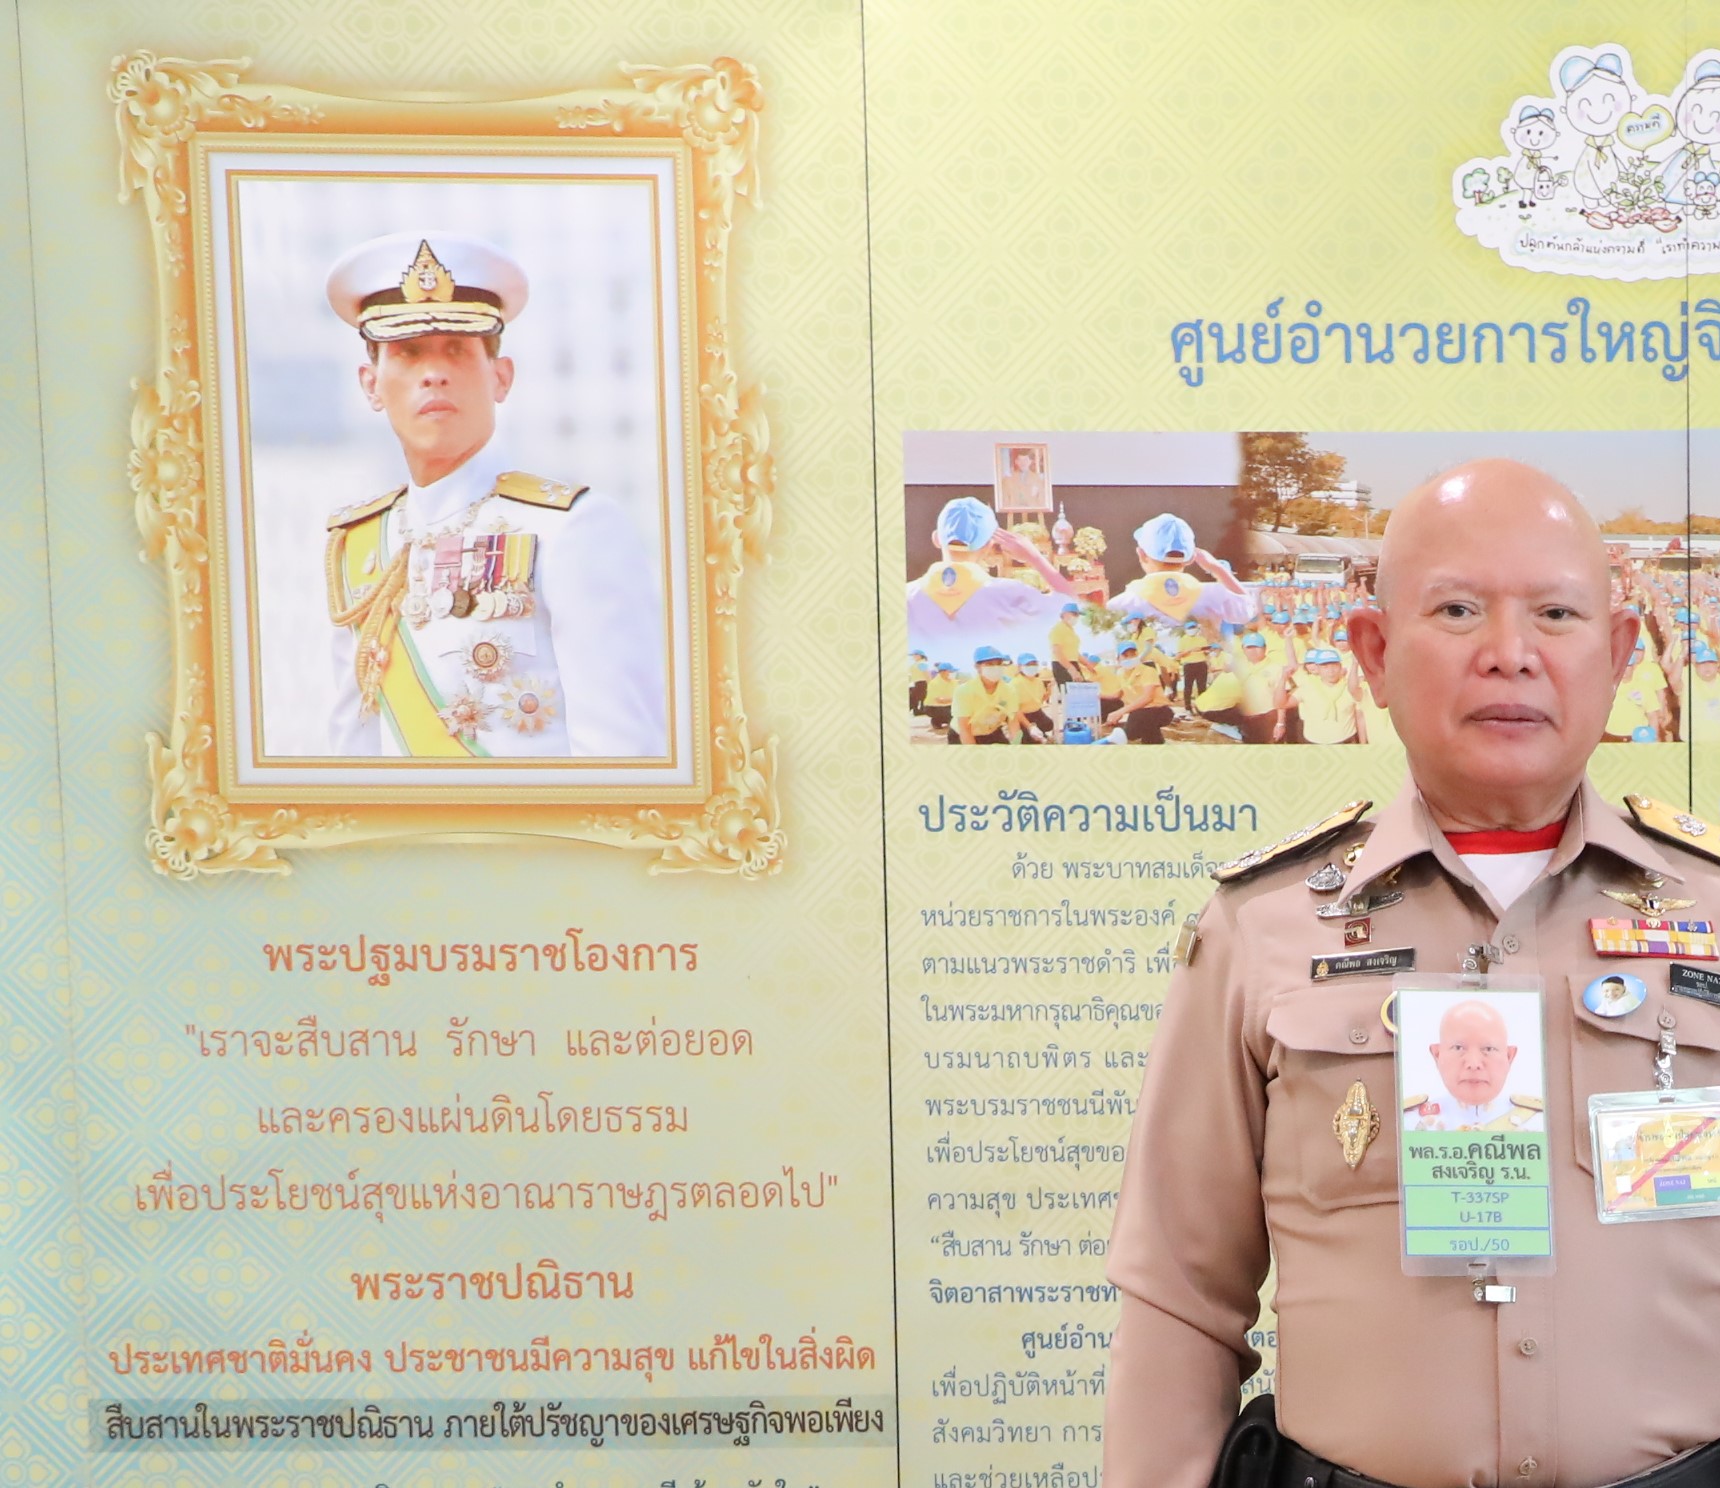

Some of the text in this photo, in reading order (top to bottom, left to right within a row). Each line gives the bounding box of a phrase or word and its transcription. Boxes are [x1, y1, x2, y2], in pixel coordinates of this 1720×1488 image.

[919, 786, 1257, 834] ประวัติความเป็นมา
[1012, 857, 1053, 881] ด้วย
[921, 899, 1176, 928] หน่วยราชการในพระองค์
[263, 928, 699, 985] พระปฐมบรมราชโองการ
[922, 943, 1177, 976] ตามแนวพระราชดำริ เพื่
[1682, 969, 1705, 981] ZONE
[185, 1014, 754, 1059] "เราจะสืบสาน รักษา และต่อยอด
[924, 1042, 1092, 1069] บรมนาถบพิตร
[257, 1092, 689, 1136] และครองแผ่นดินโดยธรรม
[927, 1131, 1125, 1171] เพื่อประโยชน์สุขขอ
[1409, 1135, 1541, 1161] พล.ร.อ.คณีพล
[1432, 1162, 1531, 1185] สงเจริญ ร.น.
[135, 1163, 840, 1222] เพื่อประโยชน์สุขแห่งอาณาราษฎรตลอดไป"
[928, 1190, 1016, 1218] ความสุข
[1451, 1192, 1510, 1205] T-337SP
[1459, 1210, 1503, 1223] U-17B
[930, 1230, 1110, 1258] “สืบสาน รักษา ต่อ
[1449, 1237, 1511, 1252] รอป./50
[351, 1259, 635, 1303] พระราชปณิธาน
[930, 1278, 1121, 1304] จิตอาสาพระราชท
[109, 1326, 875, 1384] ประเทศชาติมั่นคง ประชาชนมีความสุข แก้ไขในสิ่งผิด
[932, 1363, 1106, 1405] เพื่อปฏิบัติหน้าที่
[105, 1399, 885, 1447] สืบสานในพระราชปณิธาน ภายใต้ปรัชญาของเศรษฐกิจพอเพียง
[932, 1417, 1051, 1445] สังคมวิทยา
